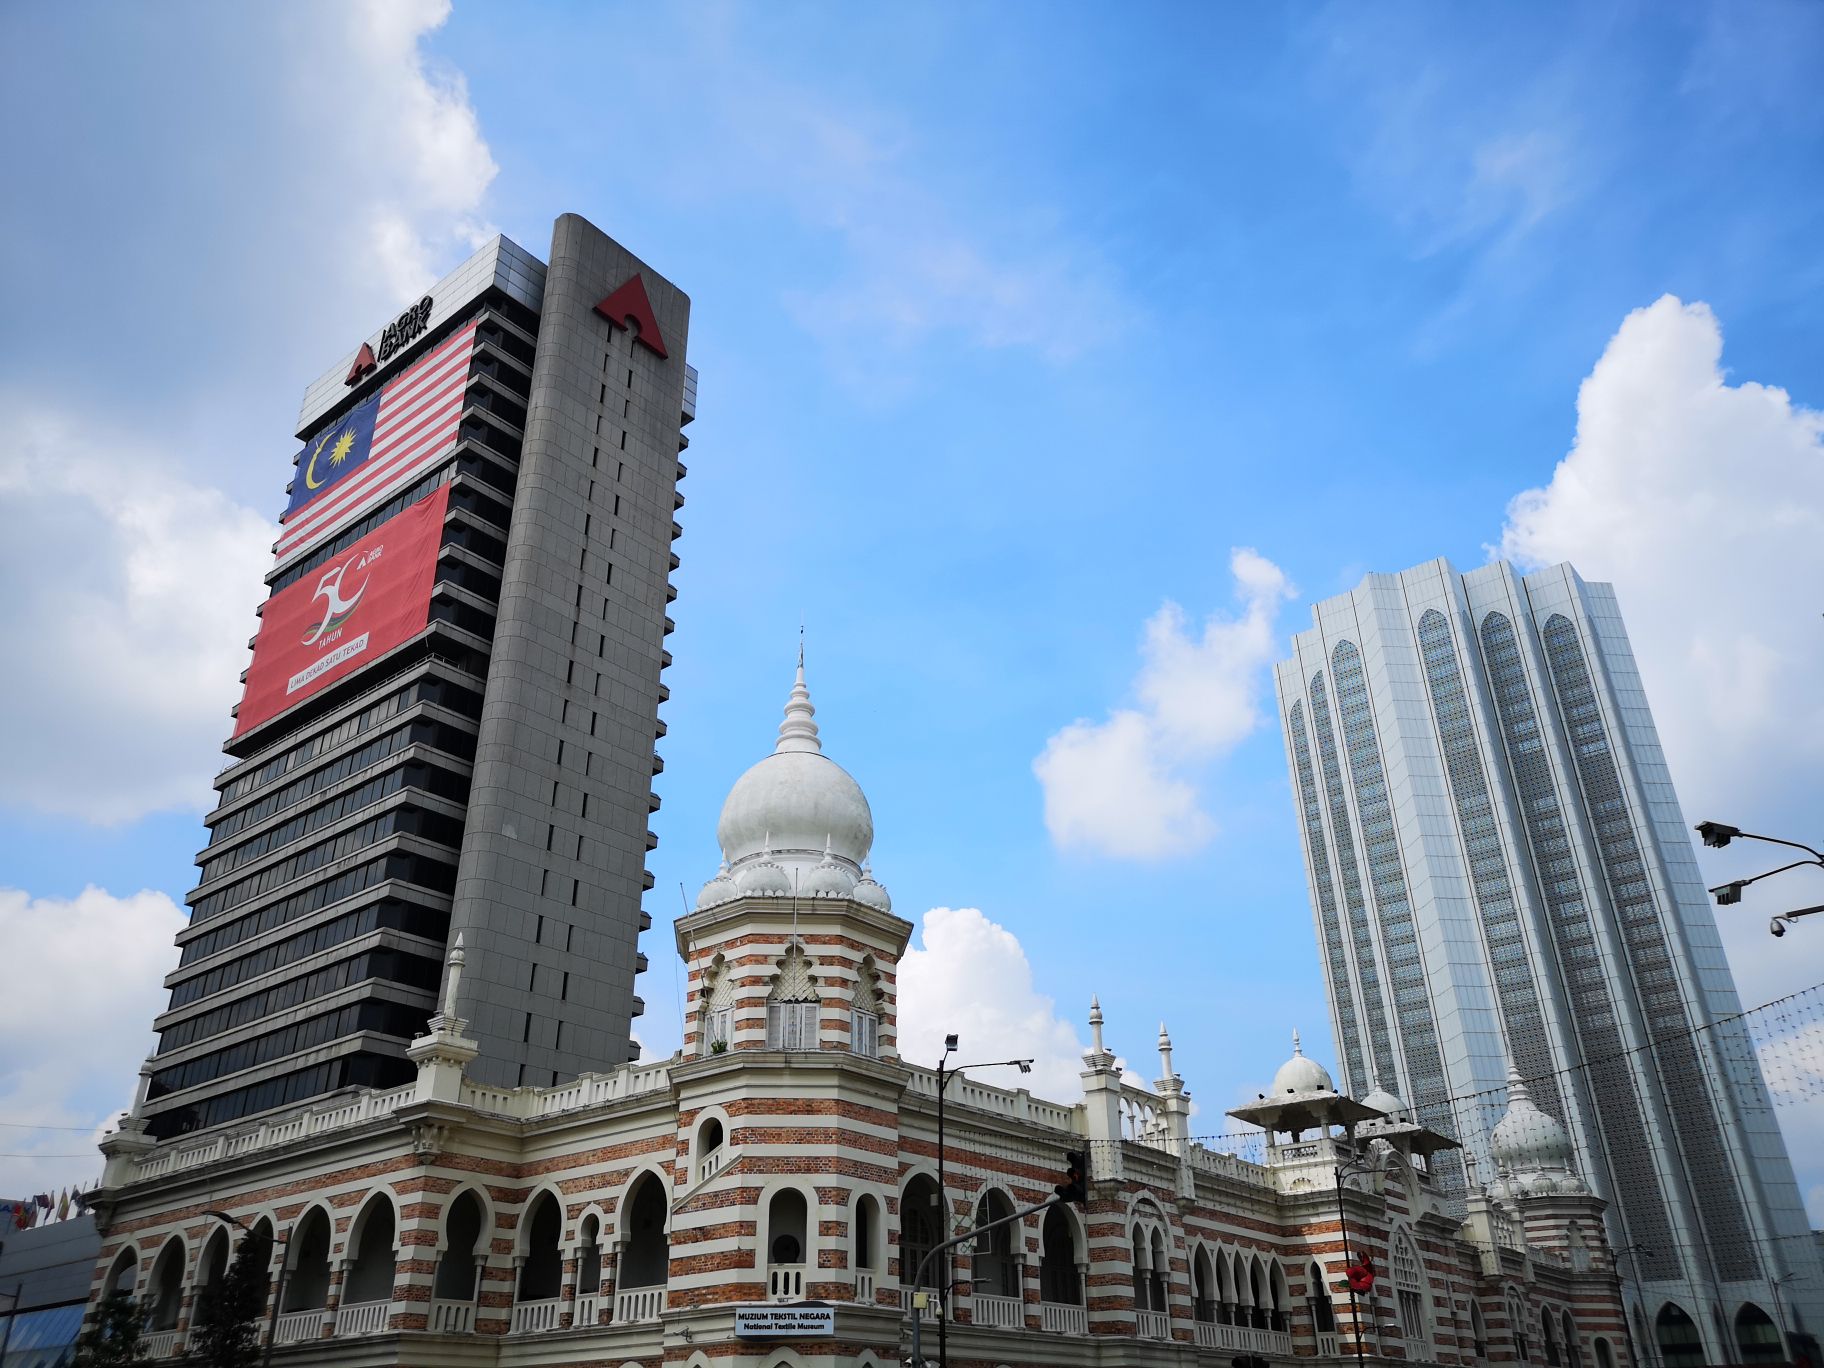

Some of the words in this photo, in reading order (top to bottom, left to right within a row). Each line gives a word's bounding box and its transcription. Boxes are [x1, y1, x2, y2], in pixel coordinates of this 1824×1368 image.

[380, 312, 431, 361] BANK
[385, 295, 433, 339] AGRO
[319, 628, 343, 650] TAHUN
[290, 676, 305, 689] LIMA
[305, 662, 325, 680] DEKAD
[325, 652, 341, 667] SATU
[343, 639, 364, 656] TEKAD
